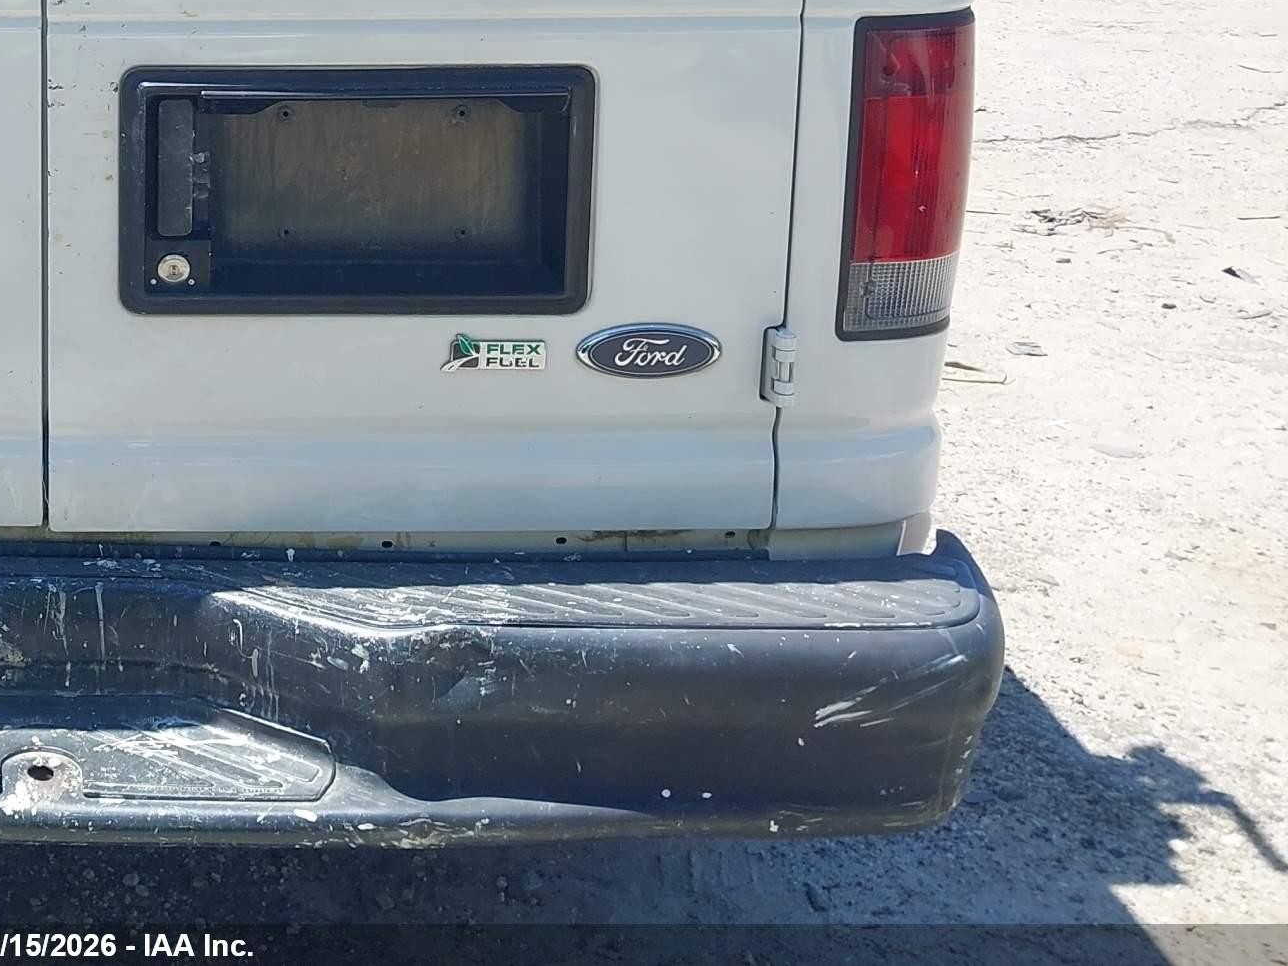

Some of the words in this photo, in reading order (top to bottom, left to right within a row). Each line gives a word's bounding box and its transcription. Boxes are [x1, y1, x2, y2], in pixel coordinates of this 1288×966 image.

[486, 343, 542, 356] FLEX
[613, 337, 688, 368] Ford
[485, 356, 541, 368] FUEL
